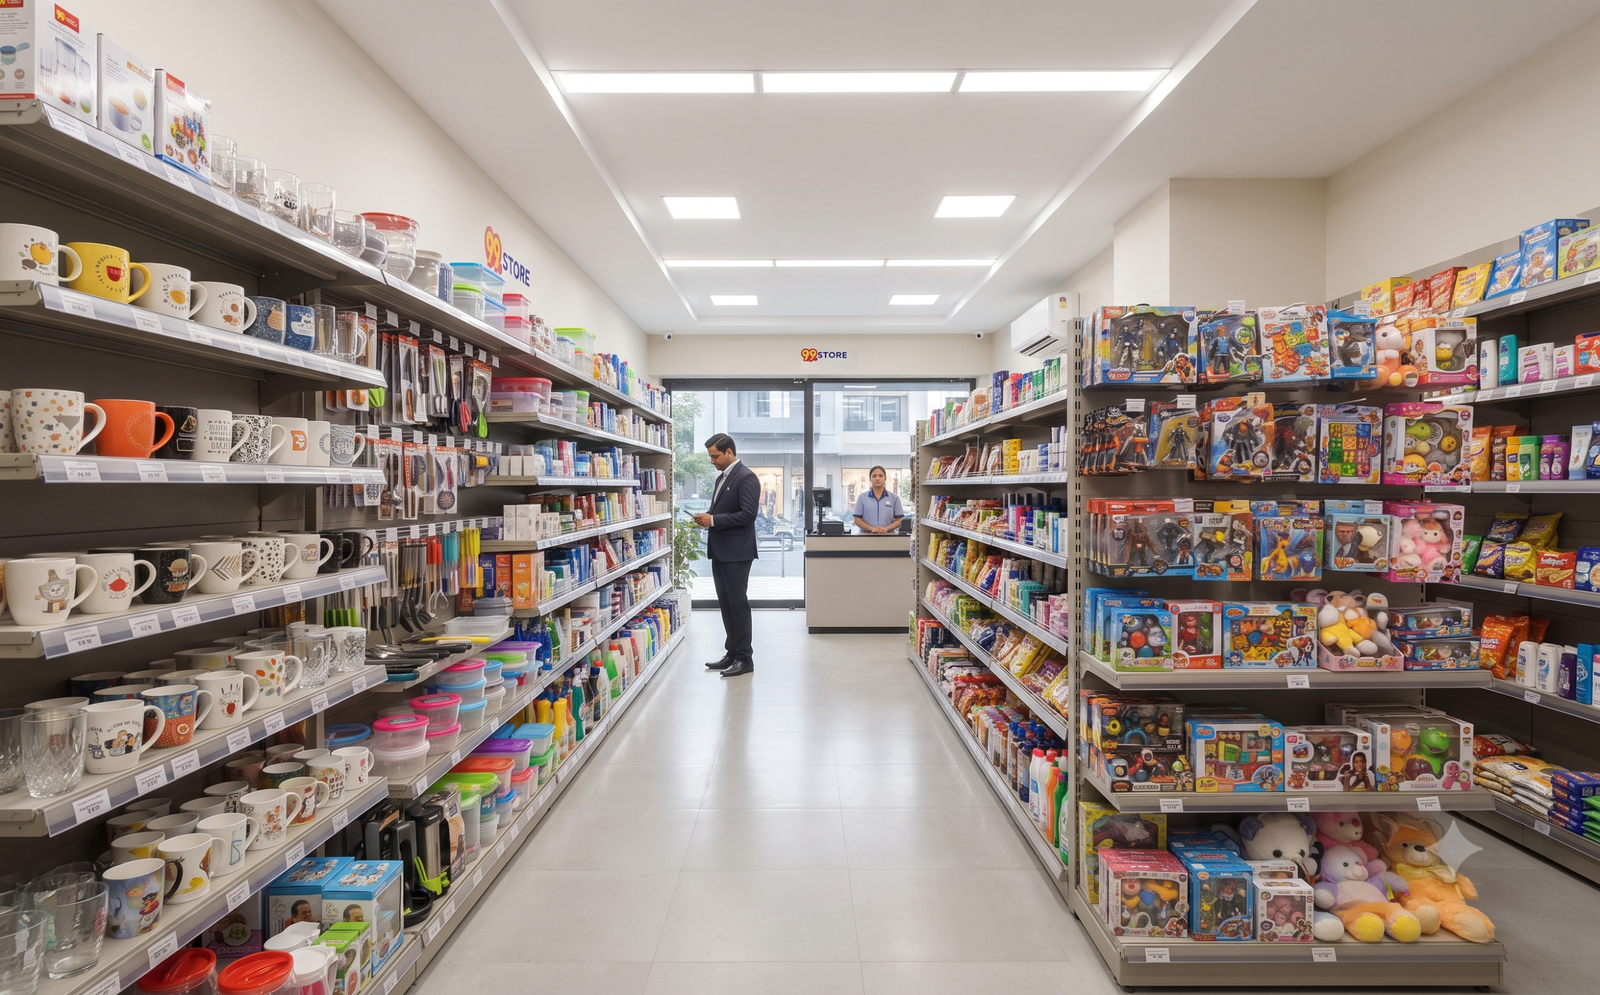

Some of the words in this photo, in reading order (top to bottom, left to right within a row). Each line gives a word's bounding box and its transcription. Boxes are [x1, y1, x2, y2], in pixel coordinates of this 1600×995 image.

[485, 227, 502, 273] 99
[503, 252, 531, 287] STORE
[801, 348, 818, 362] 99
[818, 351, 847, 359] STORE
